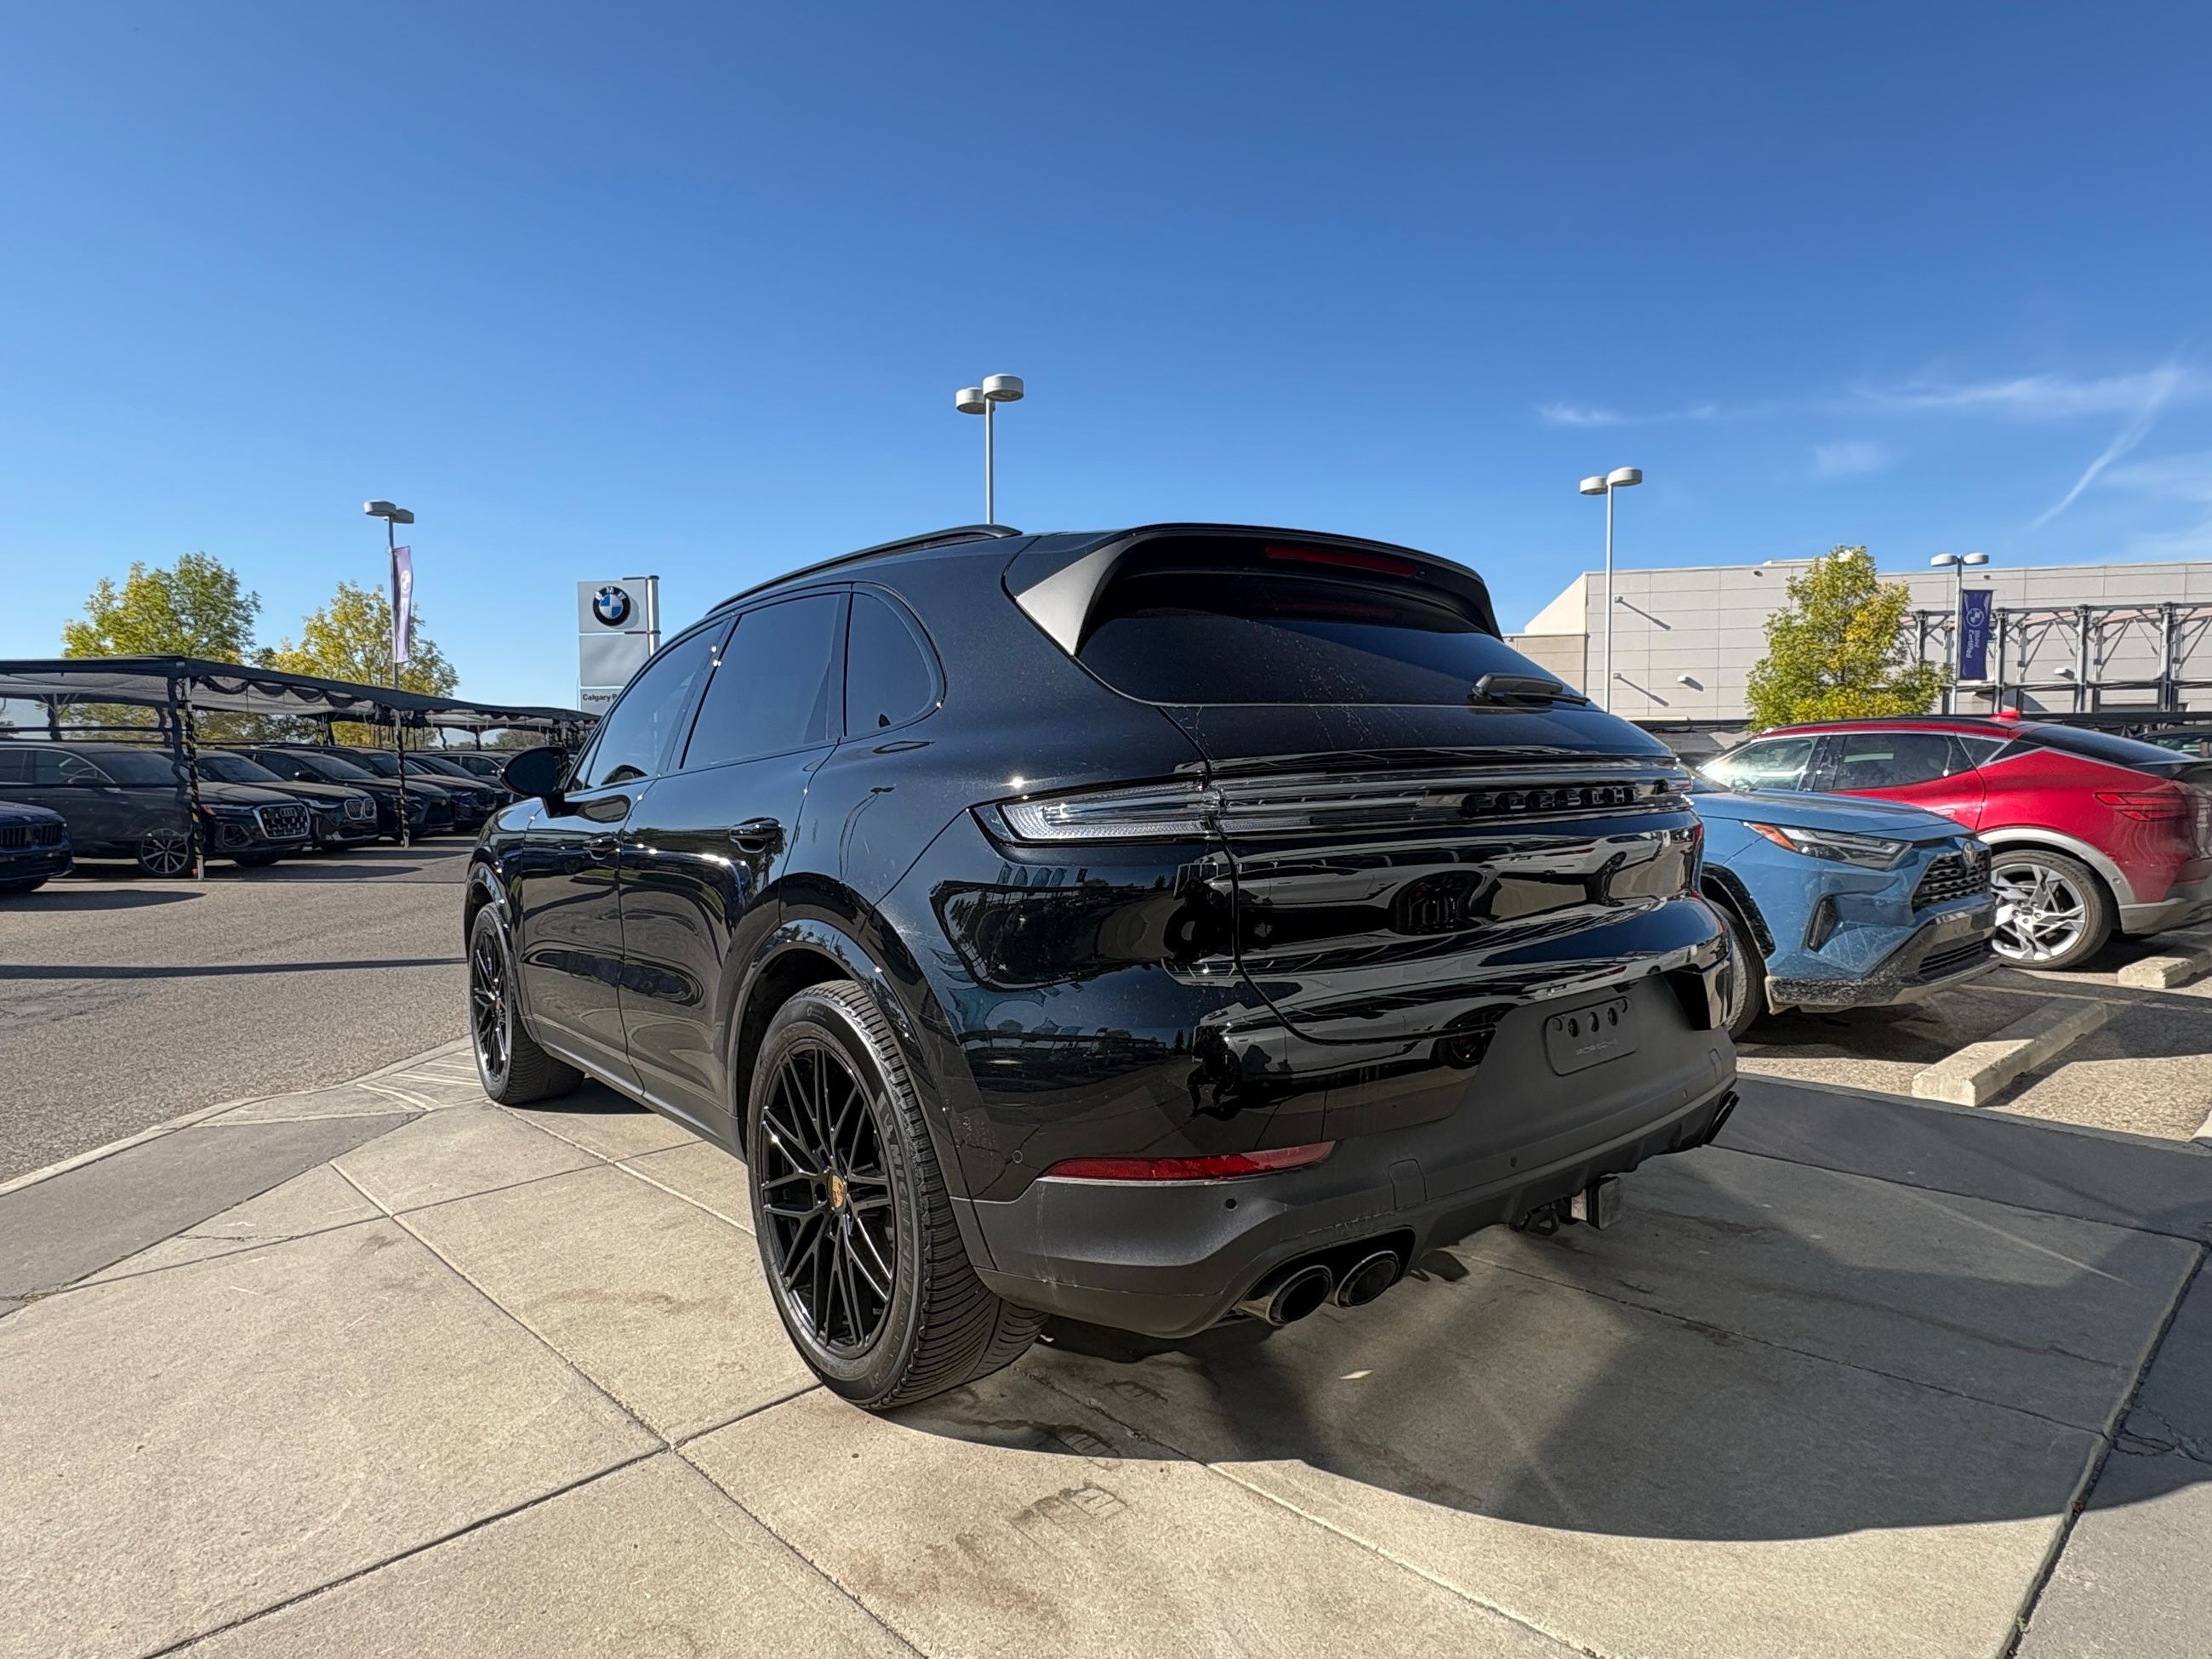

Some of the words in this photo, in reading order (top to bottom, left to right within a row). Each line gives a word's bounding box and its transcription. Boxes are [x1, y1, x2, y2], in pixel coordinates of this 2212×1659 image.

[595, 586, 627, 601] BMW
[582, 693, 611, 702] Calgary
[1461, 786, 1639, 815] PORSCHE
